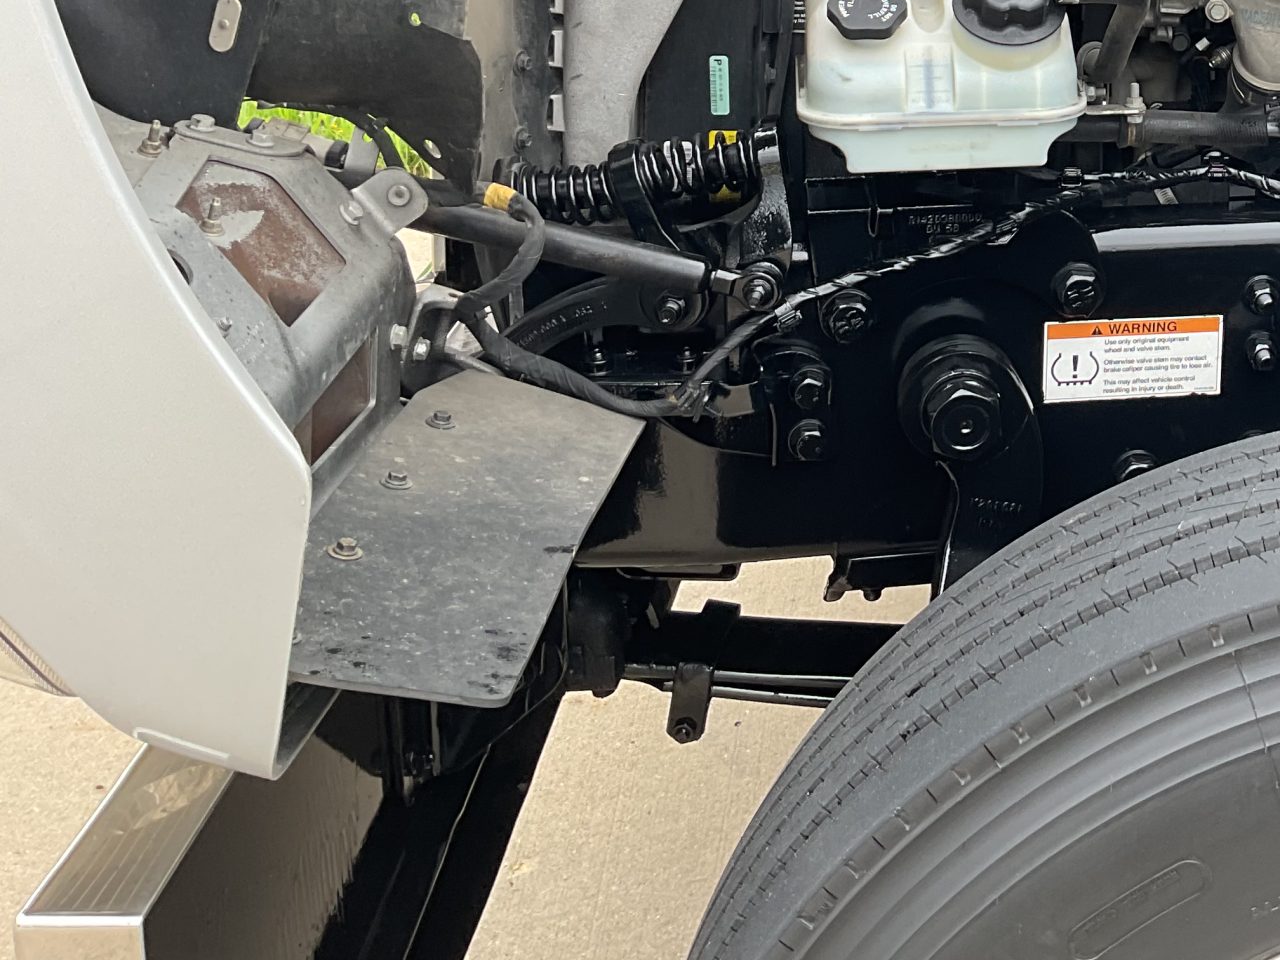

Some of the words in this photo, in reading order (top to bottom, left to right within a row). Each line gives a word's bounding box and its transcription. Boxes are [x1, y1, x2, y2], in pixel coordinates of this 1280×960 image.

[838, 0, 850, 17] POWER
[890, 4, 898, 12] DO
[881, 12, 893, 22] NOT
[1108, 321, 1177, 335] WARNING
[1118, 338, 1131, 346] only
[1132, 337, 1156, 345] original
[1157, 335, 1190, 344] equipment
[1184, 354, 1207, 362] contact
[1138, 385, 1156, 393] injury
